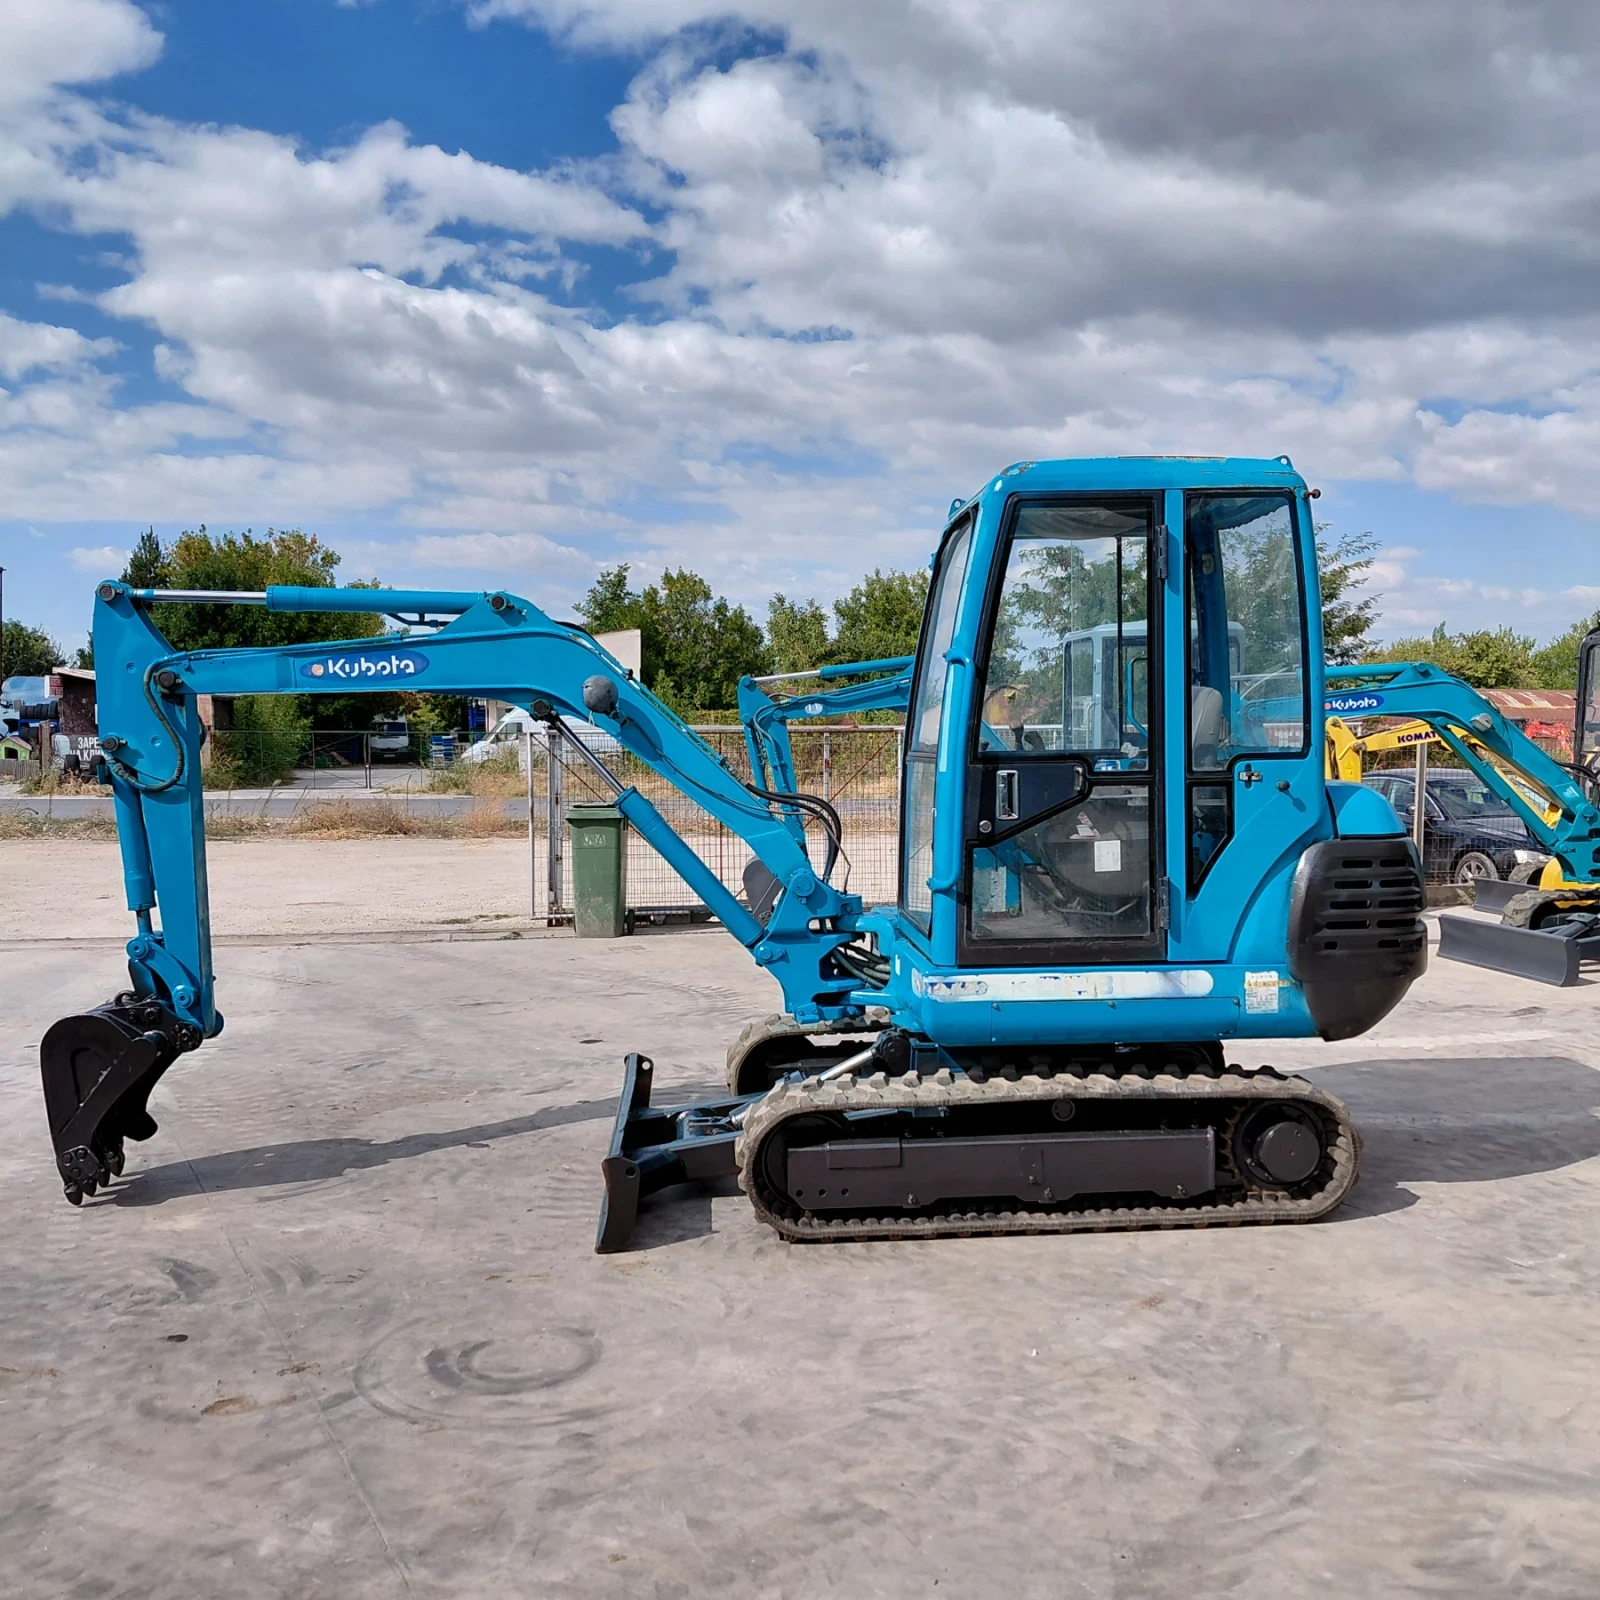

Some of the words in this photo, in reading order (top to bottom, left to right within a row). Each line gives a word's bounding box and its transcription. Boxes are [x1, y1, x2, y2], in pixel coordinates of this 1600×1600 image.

[328, 655, 415, 678] Kubota
[1332, 697, 1377, 710] Kubota
[78, 737, 101, 749] ЗАРЕ
[1397, 731, 1437, 743] KOMAT
